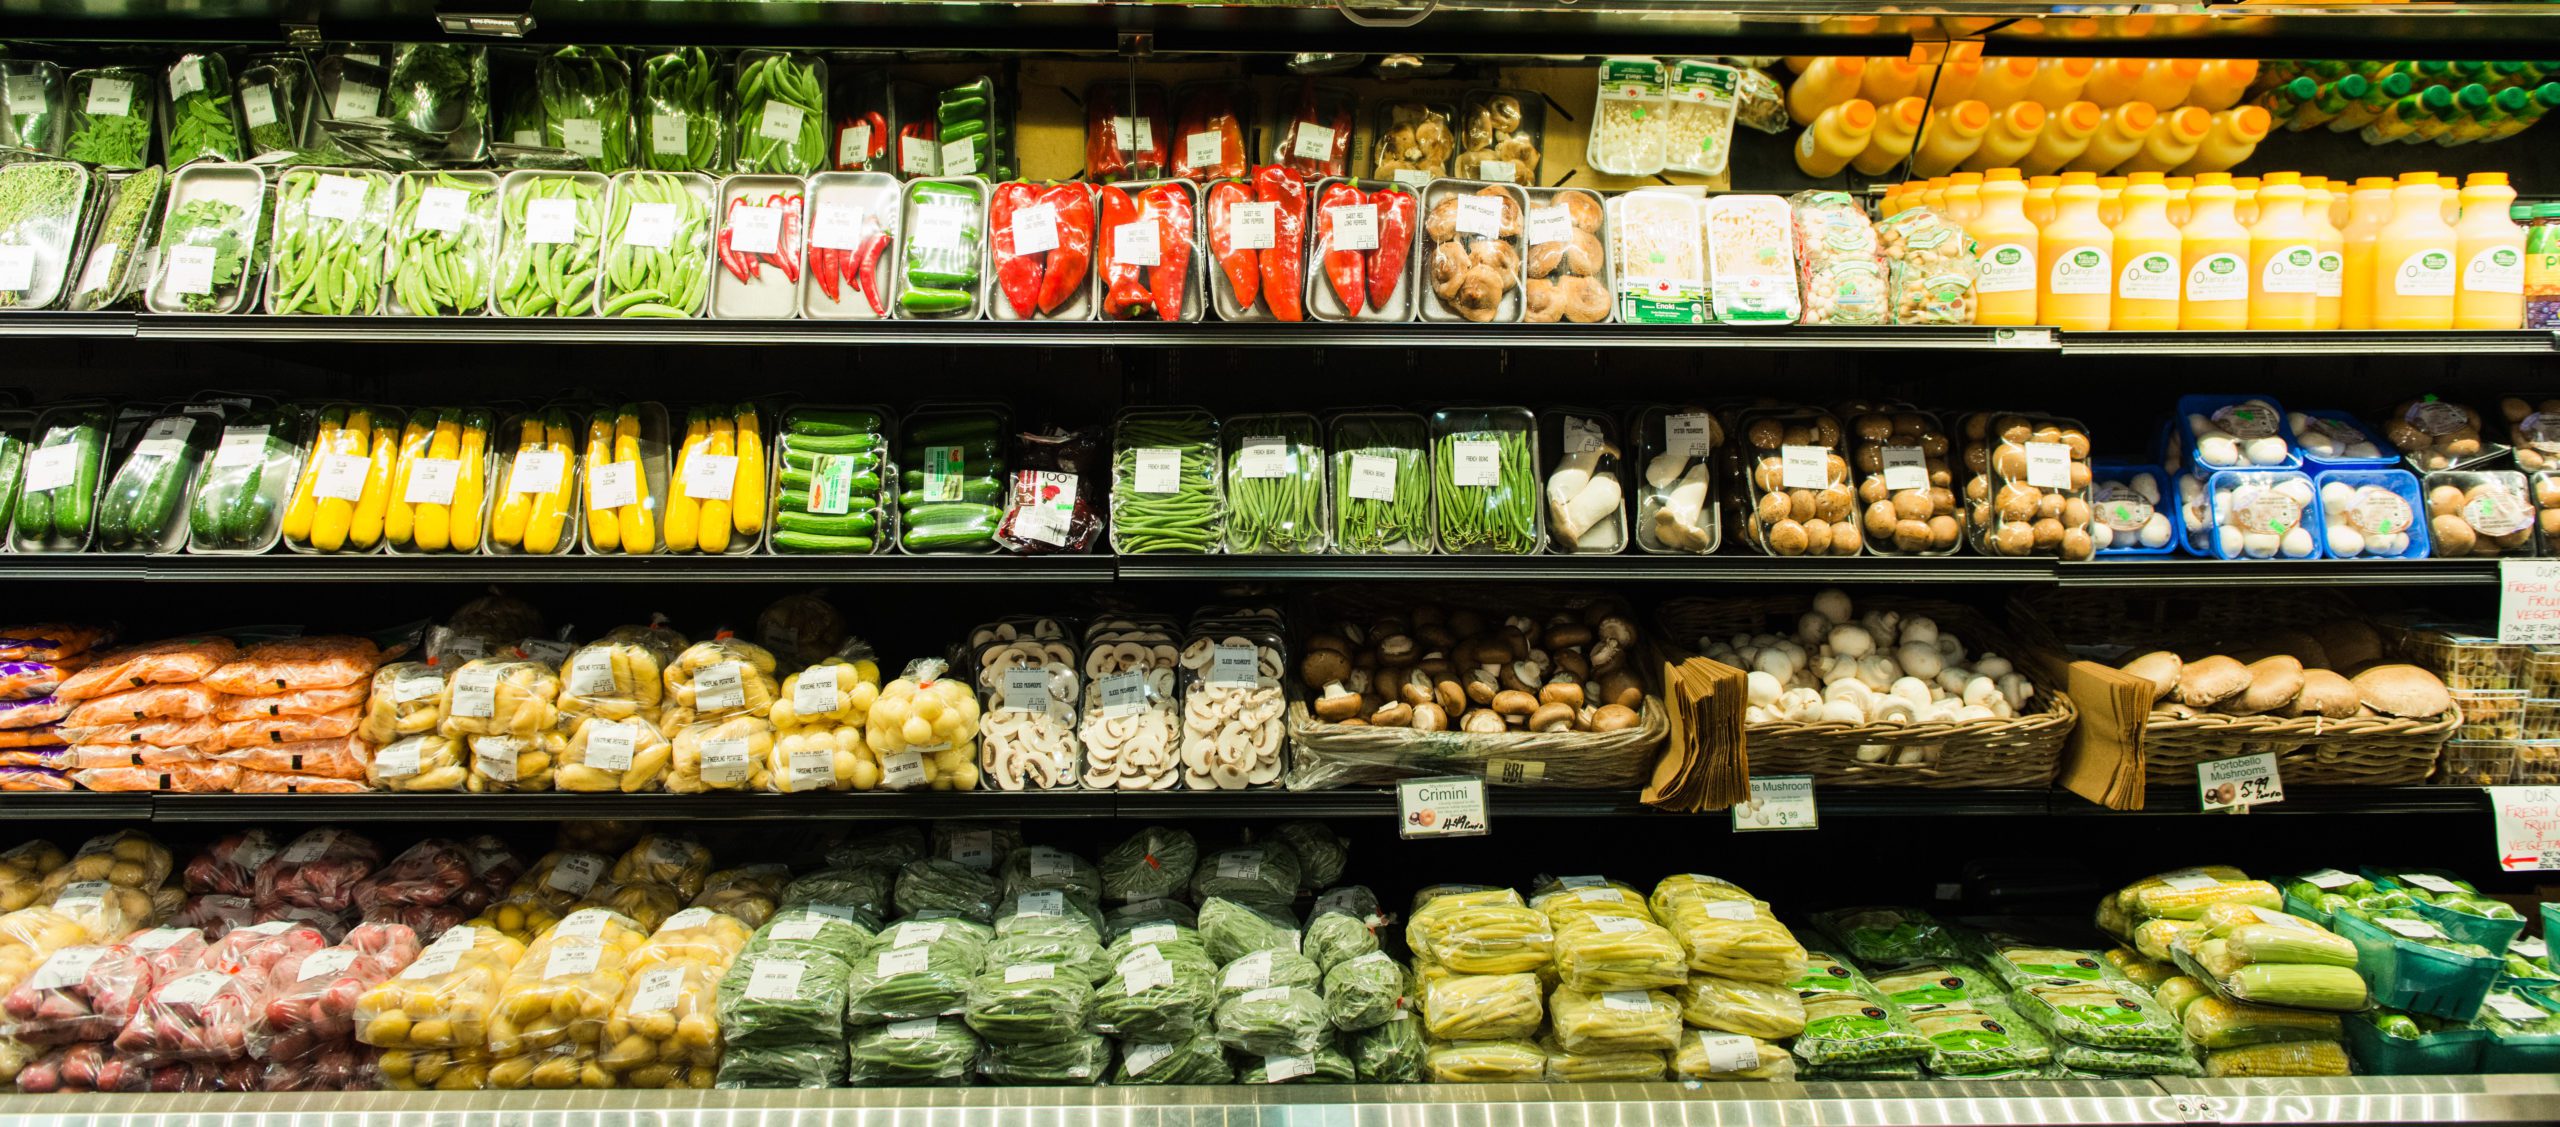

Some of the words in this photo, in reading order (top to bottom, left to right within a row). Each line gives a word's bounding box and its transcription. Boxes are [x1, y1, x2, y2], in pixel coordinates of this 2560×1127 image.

[2213, 757, 2262, 771] Portobello
[2211, 766, 2267, 781] Mushrooms
[1418, 786, 1469, 801] Crimini
[1762, 781, 1811, 792] Mushroom
[2505, 804, 2549, 819] FRESH
